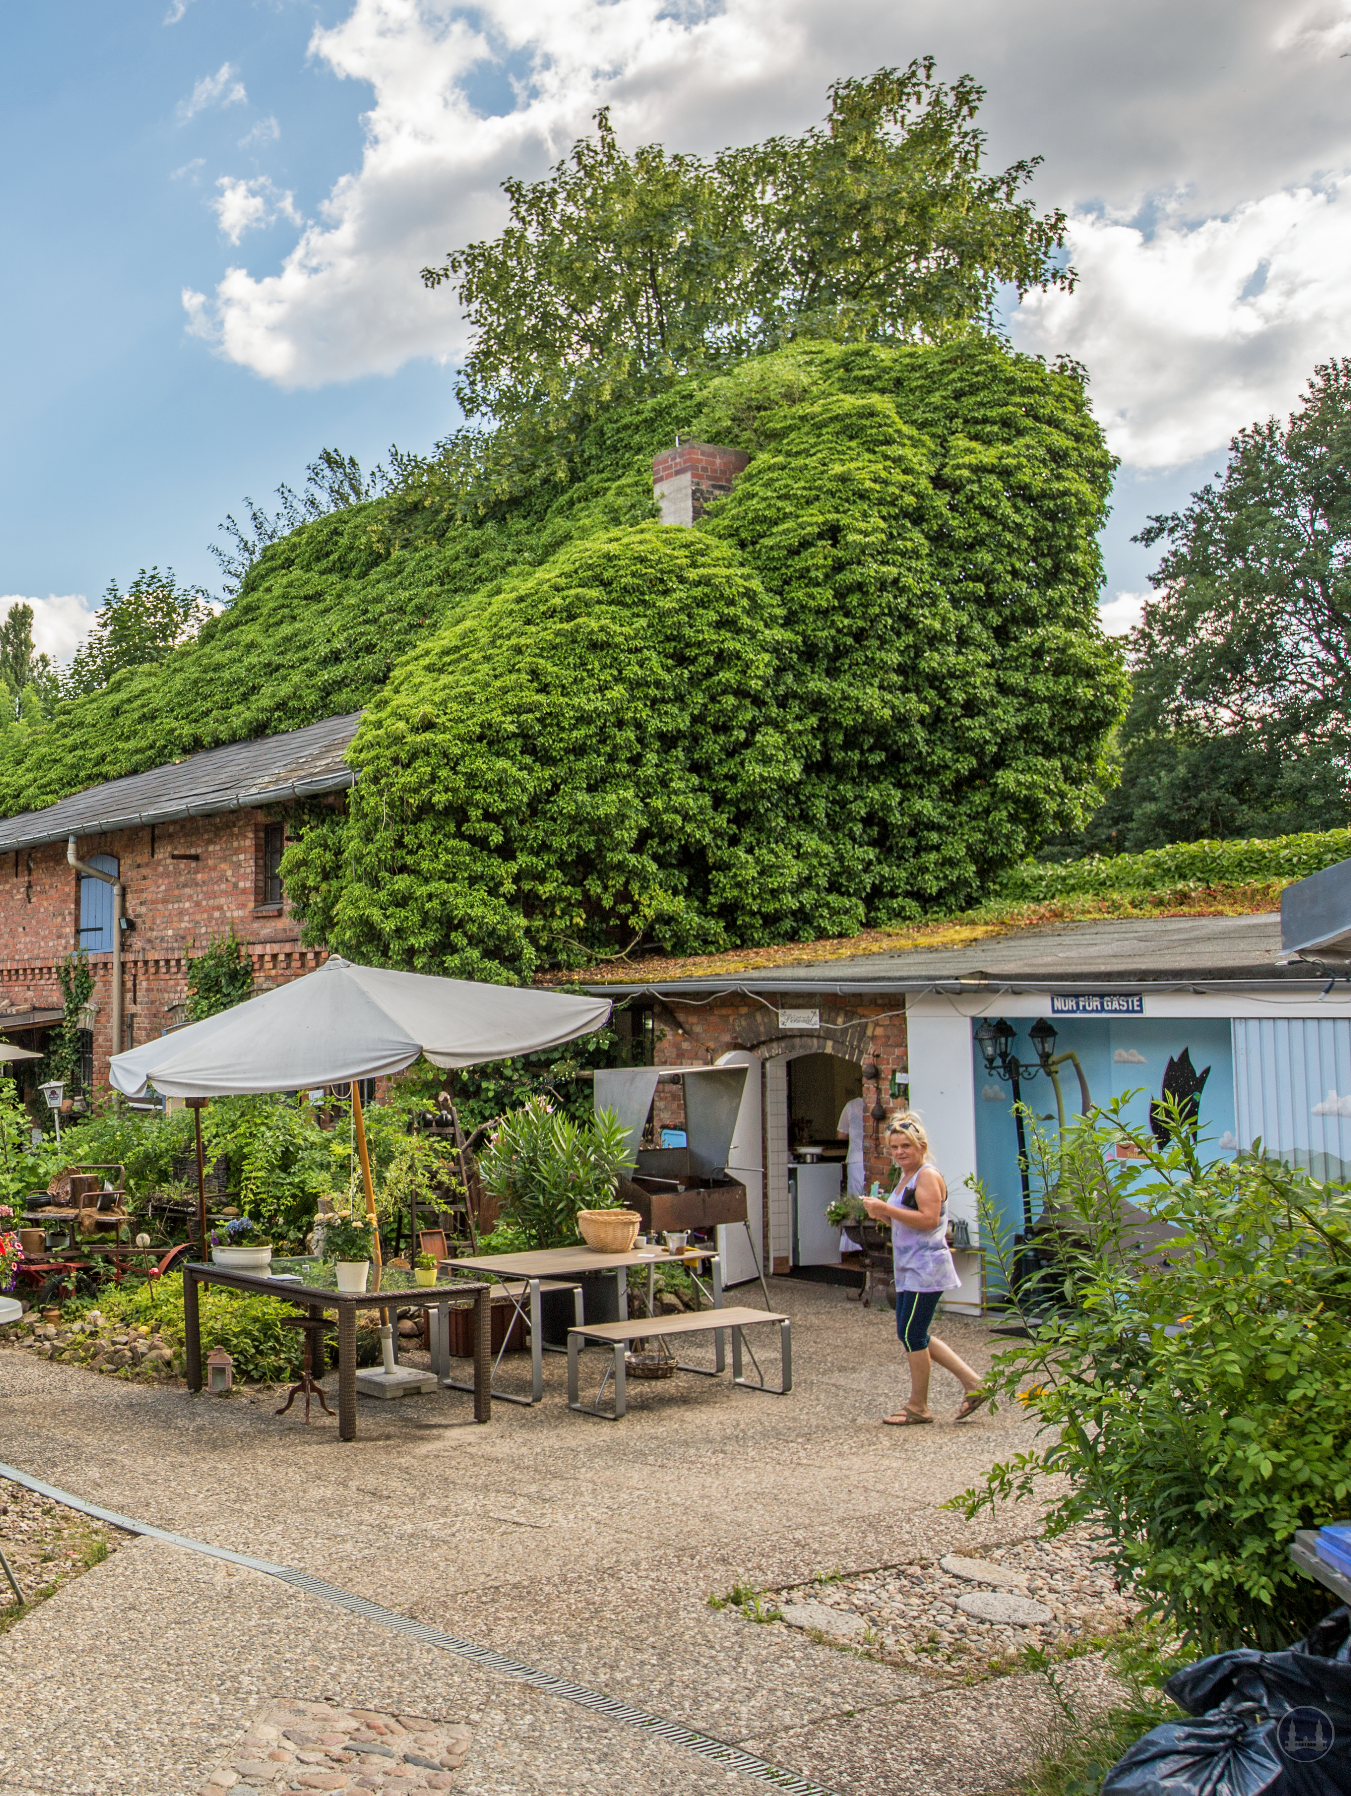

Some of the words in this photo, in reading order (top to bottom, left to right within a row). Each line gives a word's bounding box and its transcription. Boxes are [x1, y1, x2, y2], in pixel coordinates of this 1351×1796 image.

[1053, 997, 1076, 1011] NUR
[1078, 995, 1101, 1011] FÜR
[1103, 995, 1141, 1011] GÄSTE
